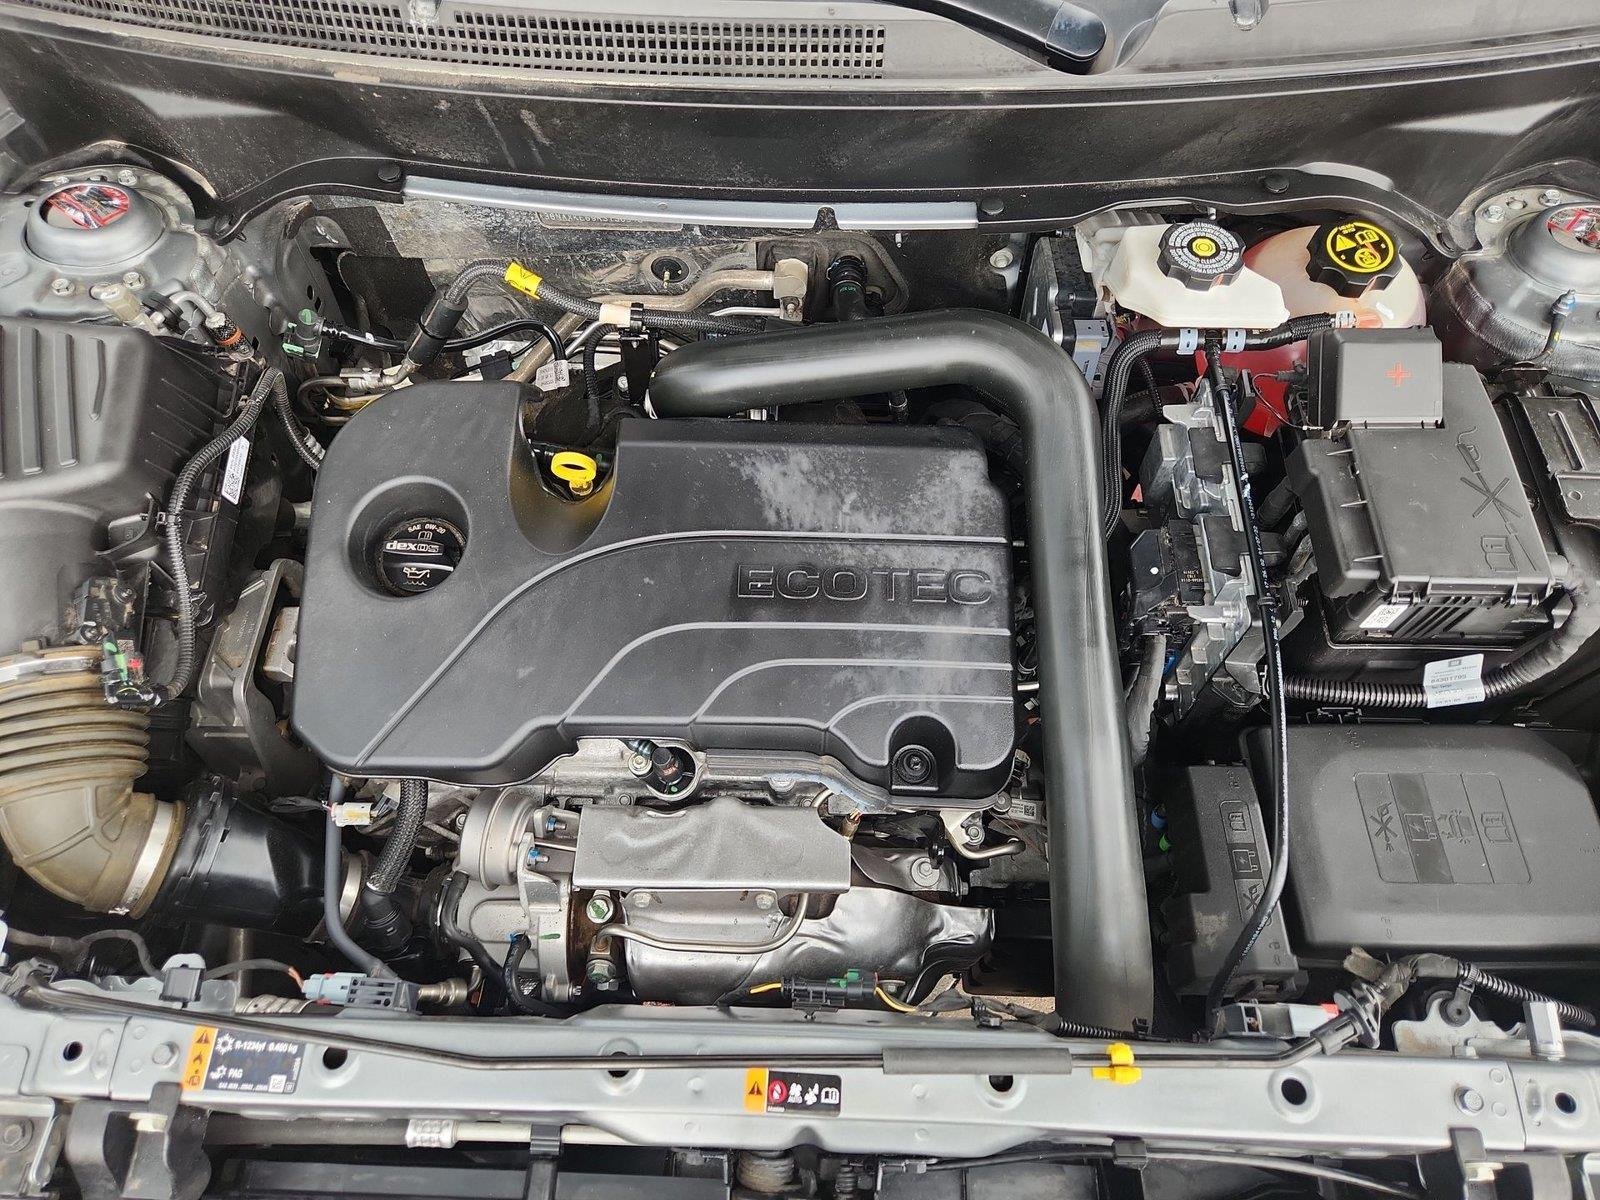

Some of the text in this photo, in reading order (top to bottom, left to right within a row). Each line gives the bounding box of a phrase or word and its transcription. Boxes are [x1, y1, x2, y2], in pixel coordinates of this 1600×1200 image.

[408, 523, 446, 534] SAE 0W-20
[386, 540, 439, 553] dexos
[737, 563, 992, 605] ECOTEC
[228, 1067, 243, 1079] PAG
